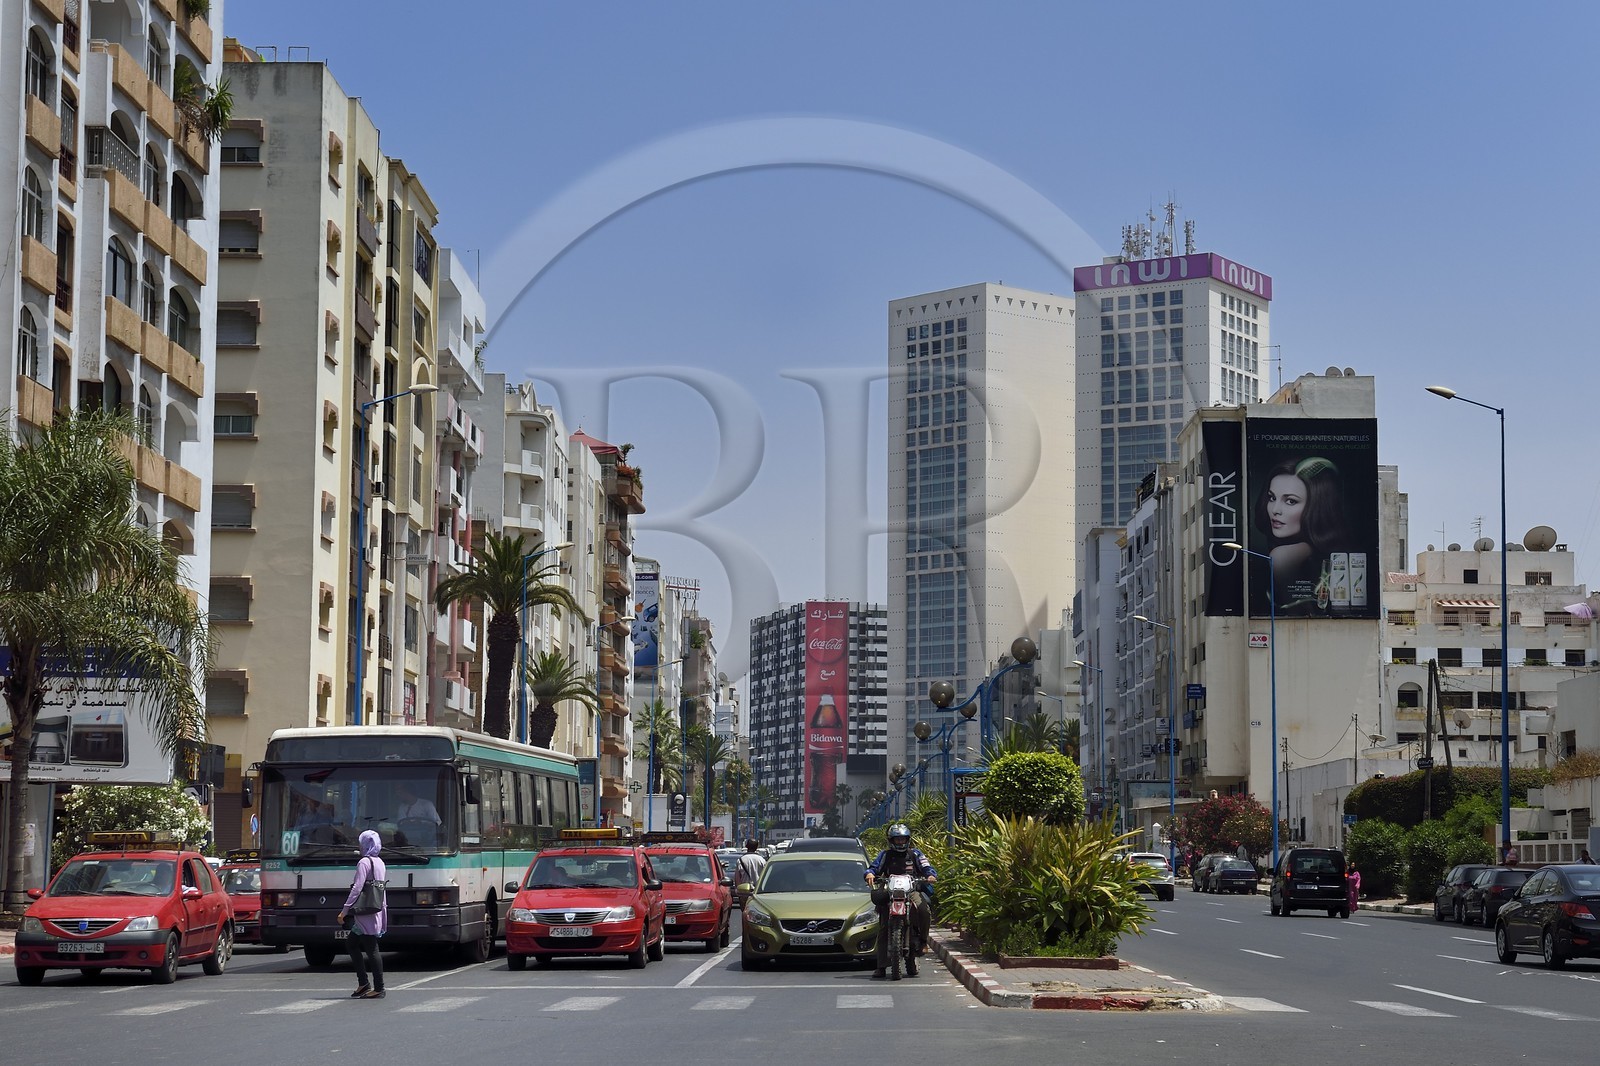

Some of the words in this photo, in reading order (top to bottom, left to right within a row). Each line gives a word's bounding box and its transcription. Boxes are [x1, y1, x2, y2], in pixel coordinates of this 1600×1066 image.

[1095, 258, 1188, 287] inwi
[1221, 258, 1263, 295] inwi
[1209, 471, 1237, 567] CLEAR
[811, 609, 844, 621] شارك
[820, 669, 836, 681] مع
[66, 696, 77, 712] في
[82, 697, 127, 707] مساهمة
[1105, 707, 1117, 725] 2
[810, 733, 843, 743] Bidawa
[564, 830, 582, 838] TAXI
[282, 832, 299, 855] 60
